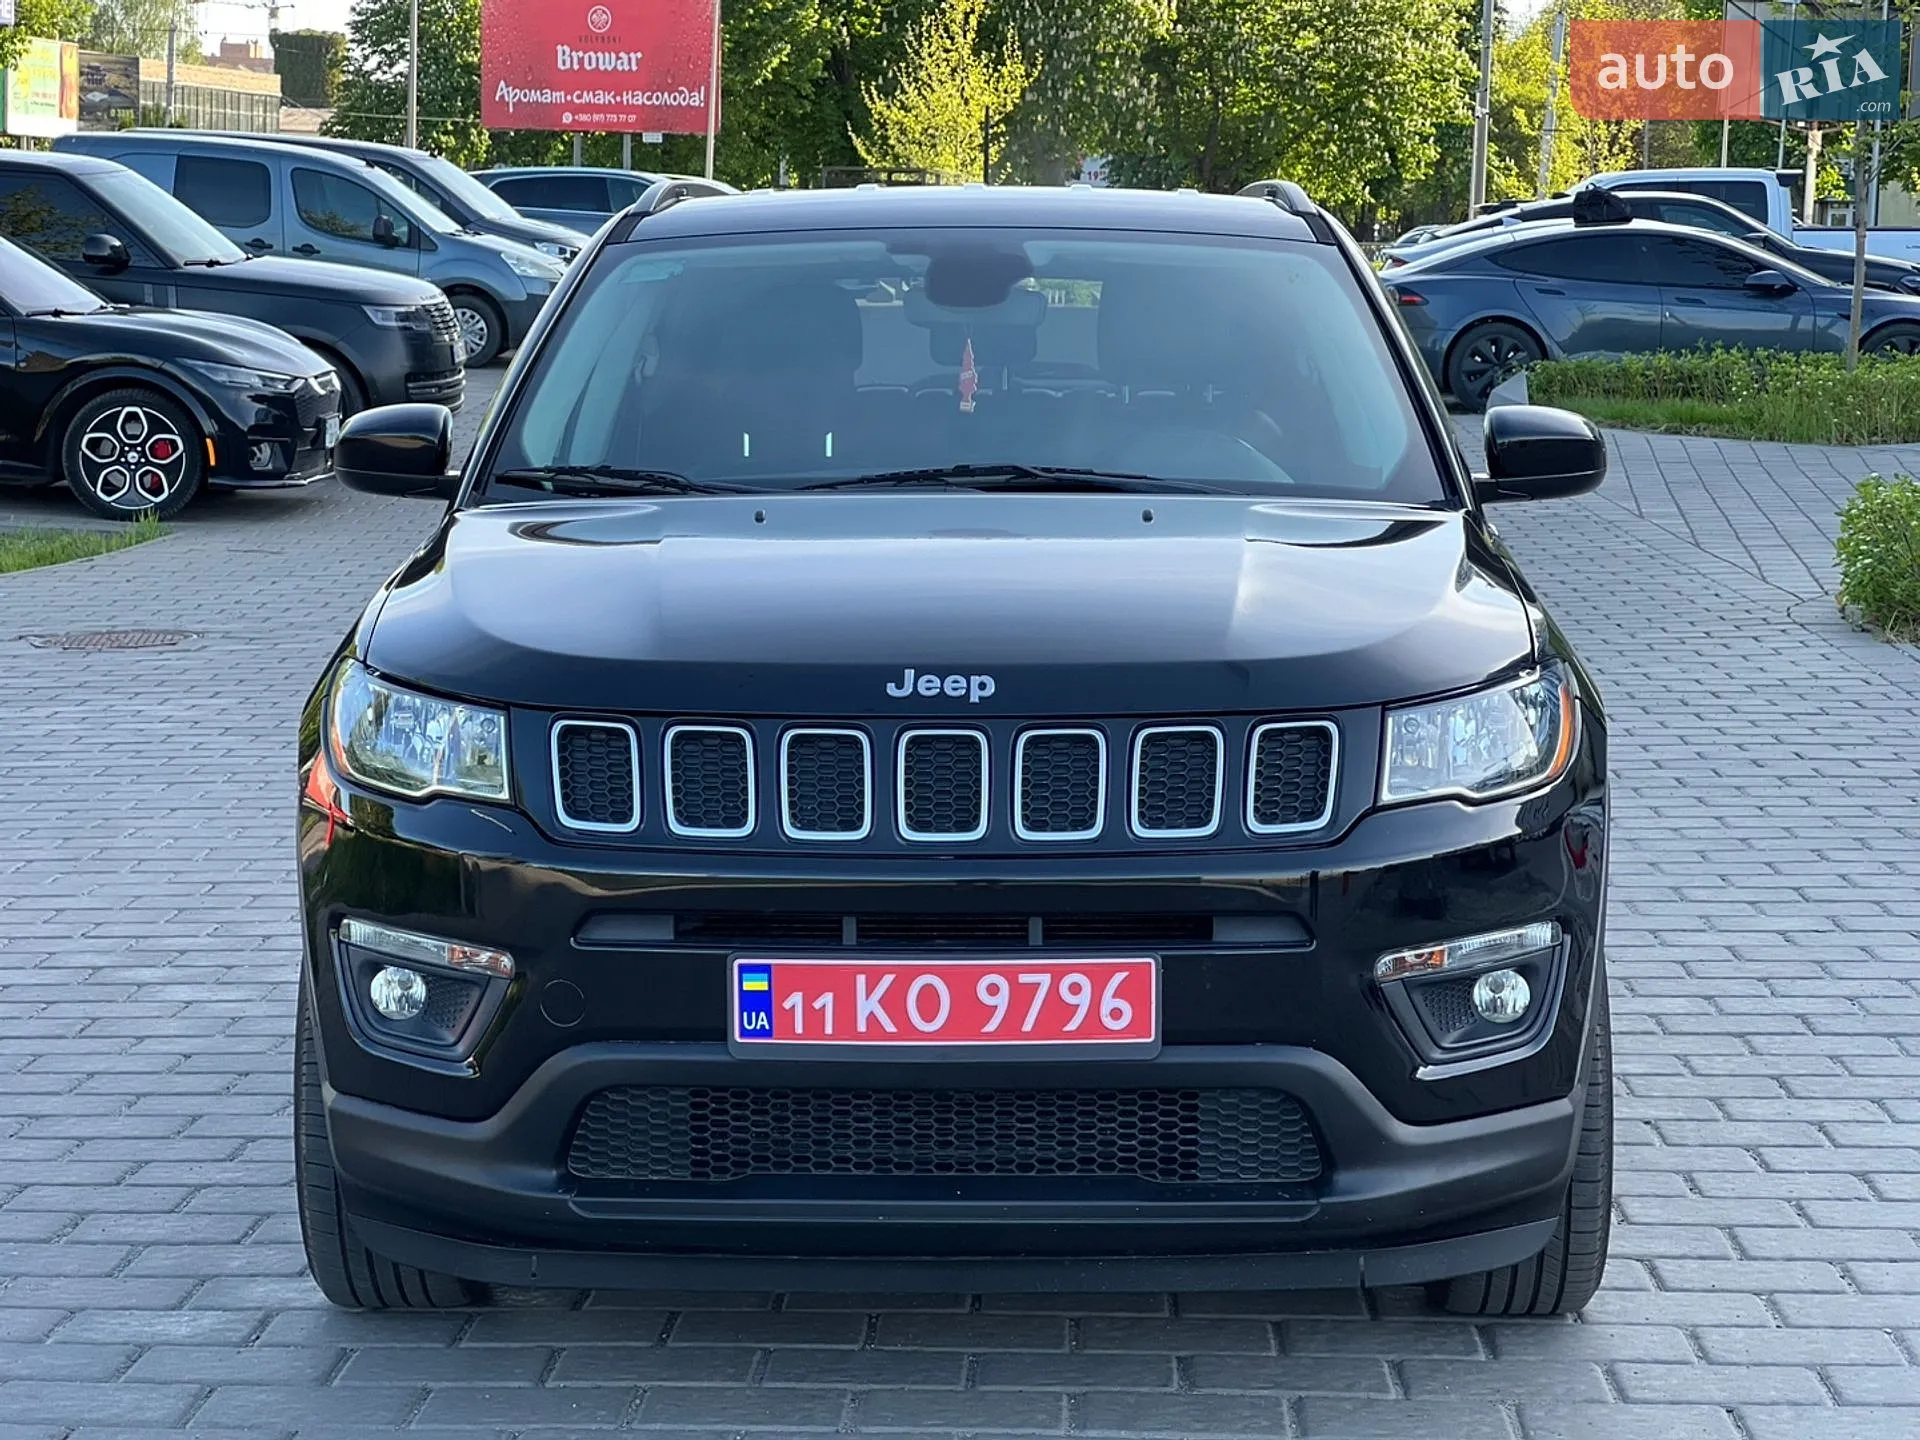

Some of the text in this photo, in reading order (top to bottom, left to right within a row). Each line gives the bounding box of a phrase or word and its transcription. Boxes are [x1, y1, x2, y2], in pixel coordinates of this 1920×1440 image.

[556, 44, 643, 71] Browar
[886, 668, 996, 703] Jeep
[782, 991, 834, 1035] 11
[976, 971, 1133, 1033] 9796
[743, 1011, 770, 1031] UA
